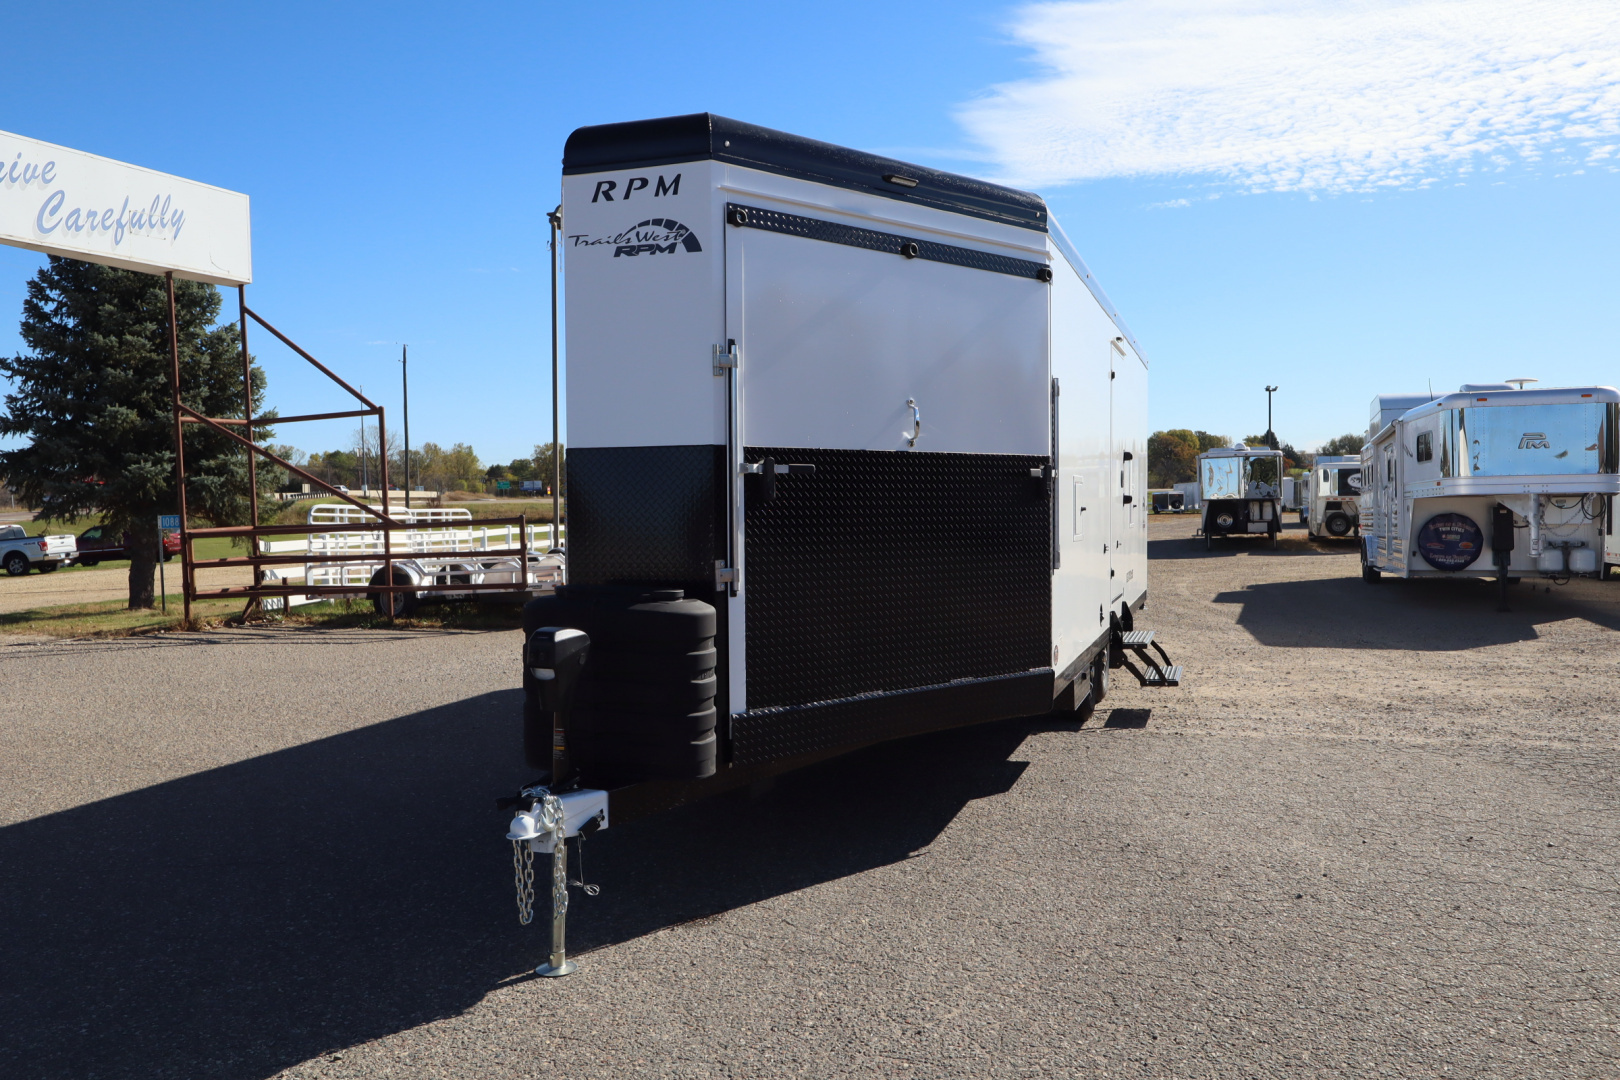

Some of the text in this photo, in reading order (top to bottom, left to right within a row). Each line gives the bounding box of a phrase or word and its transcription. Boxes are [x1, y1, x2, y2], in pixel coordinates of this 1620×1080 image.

[591, 173, 682, 203] RPM
[36, 189, 186, 246] Carefully
[635, 230, 686, 243] West
[613, 242, 678, 258] RPM
[162, 516, 180, 527] 1088
